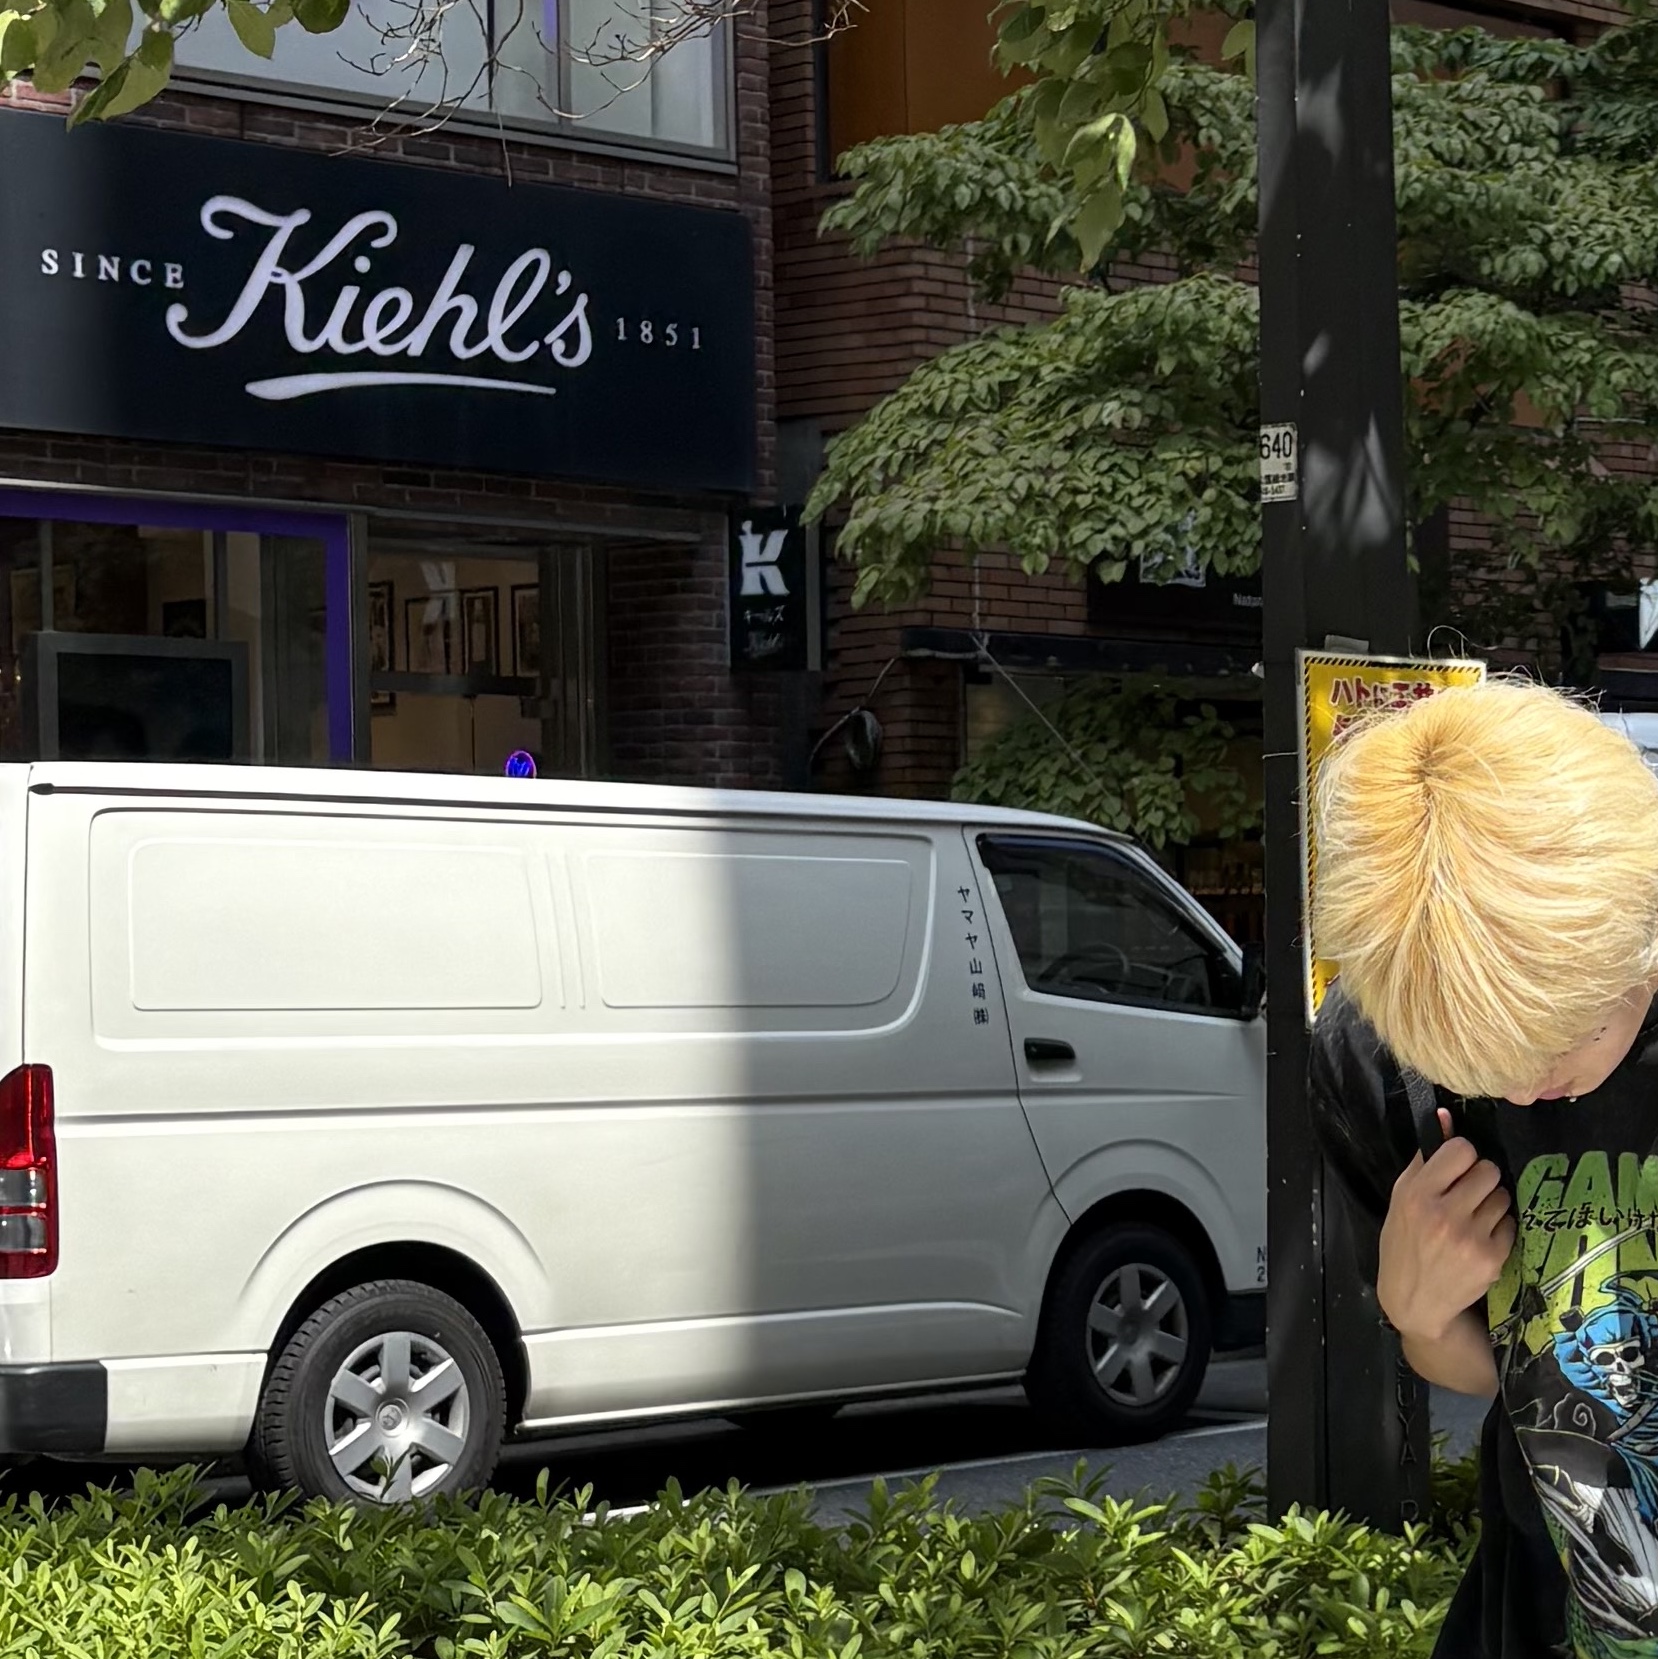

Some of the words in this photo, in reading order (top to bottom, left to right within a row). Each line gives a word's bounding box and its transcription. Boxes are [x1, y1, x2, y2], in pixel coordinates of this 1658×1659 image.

[41, 249, 185, 290] SINCE
[165, 195, 593, 368] Kiehl's
[616, 318, 702, 350] 1851
